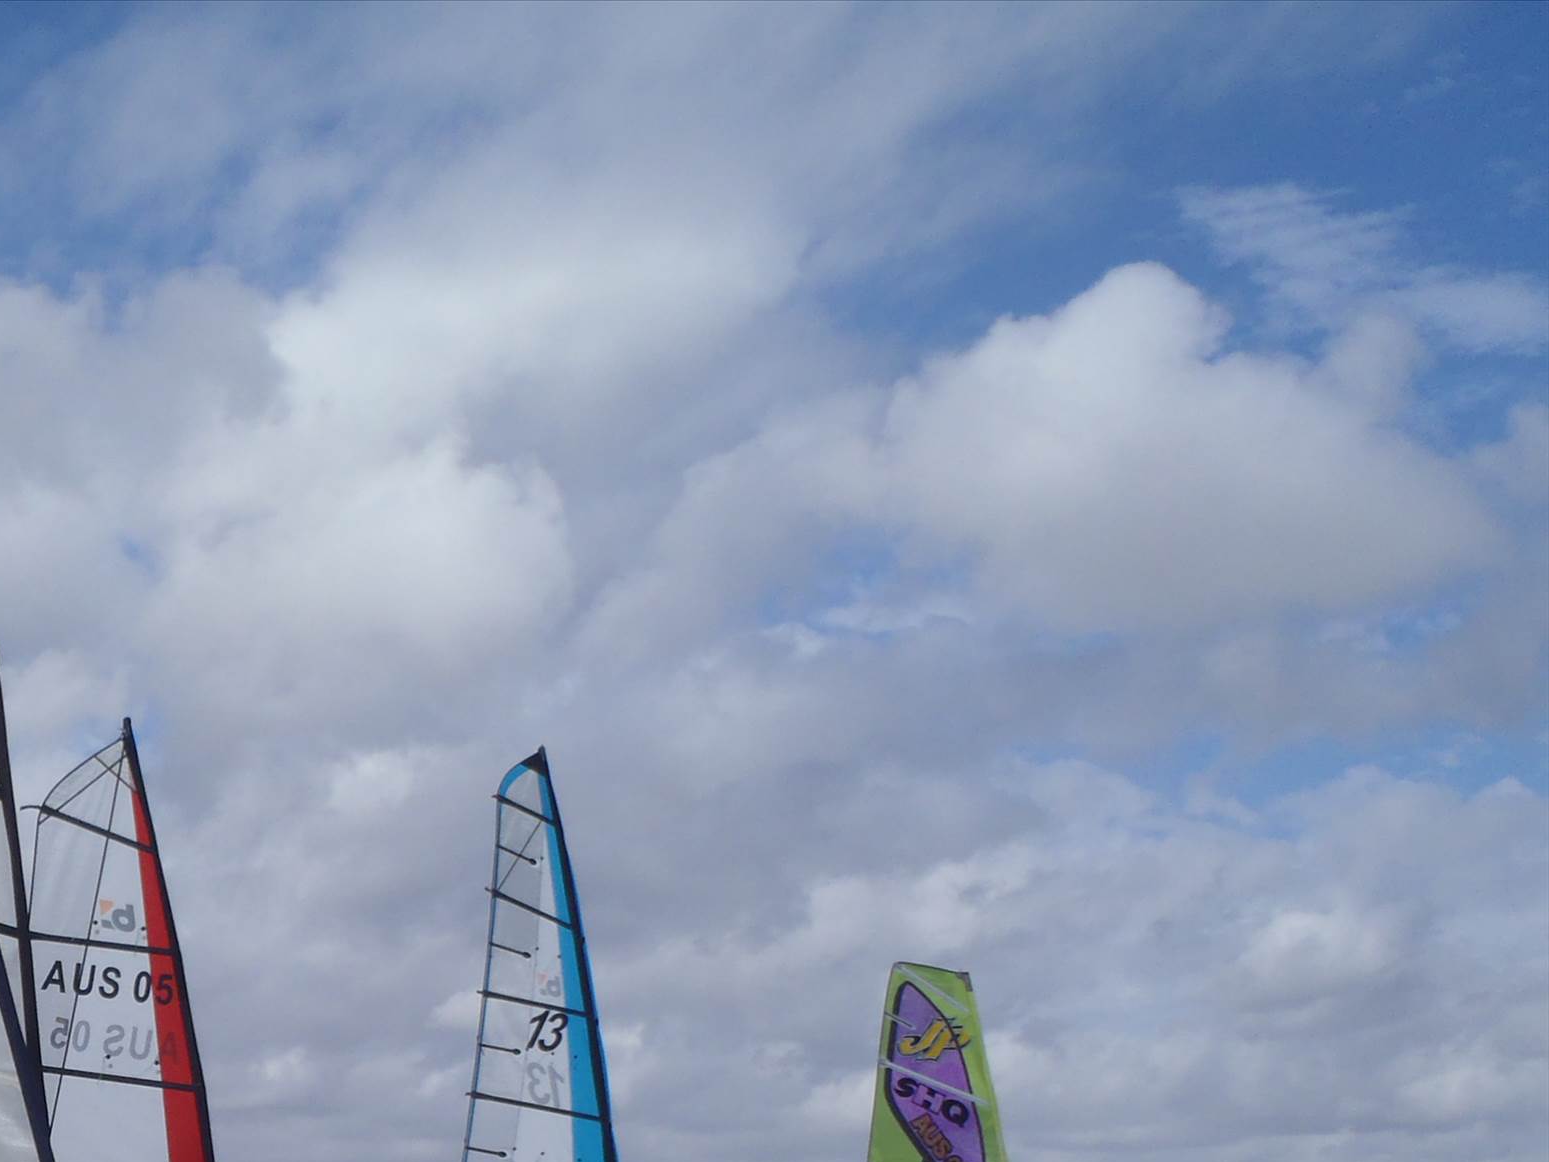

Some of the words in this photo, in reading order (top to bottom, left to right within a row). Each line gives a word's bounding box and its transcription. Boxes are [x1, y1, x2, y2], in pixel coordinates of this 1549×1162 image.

[41, 960, 122, 999] AUS
[134, 971, 174, 1006] 05
[526, 1010, 569, 1053] 13
[894, 1077, 970, 1129] SHQ
